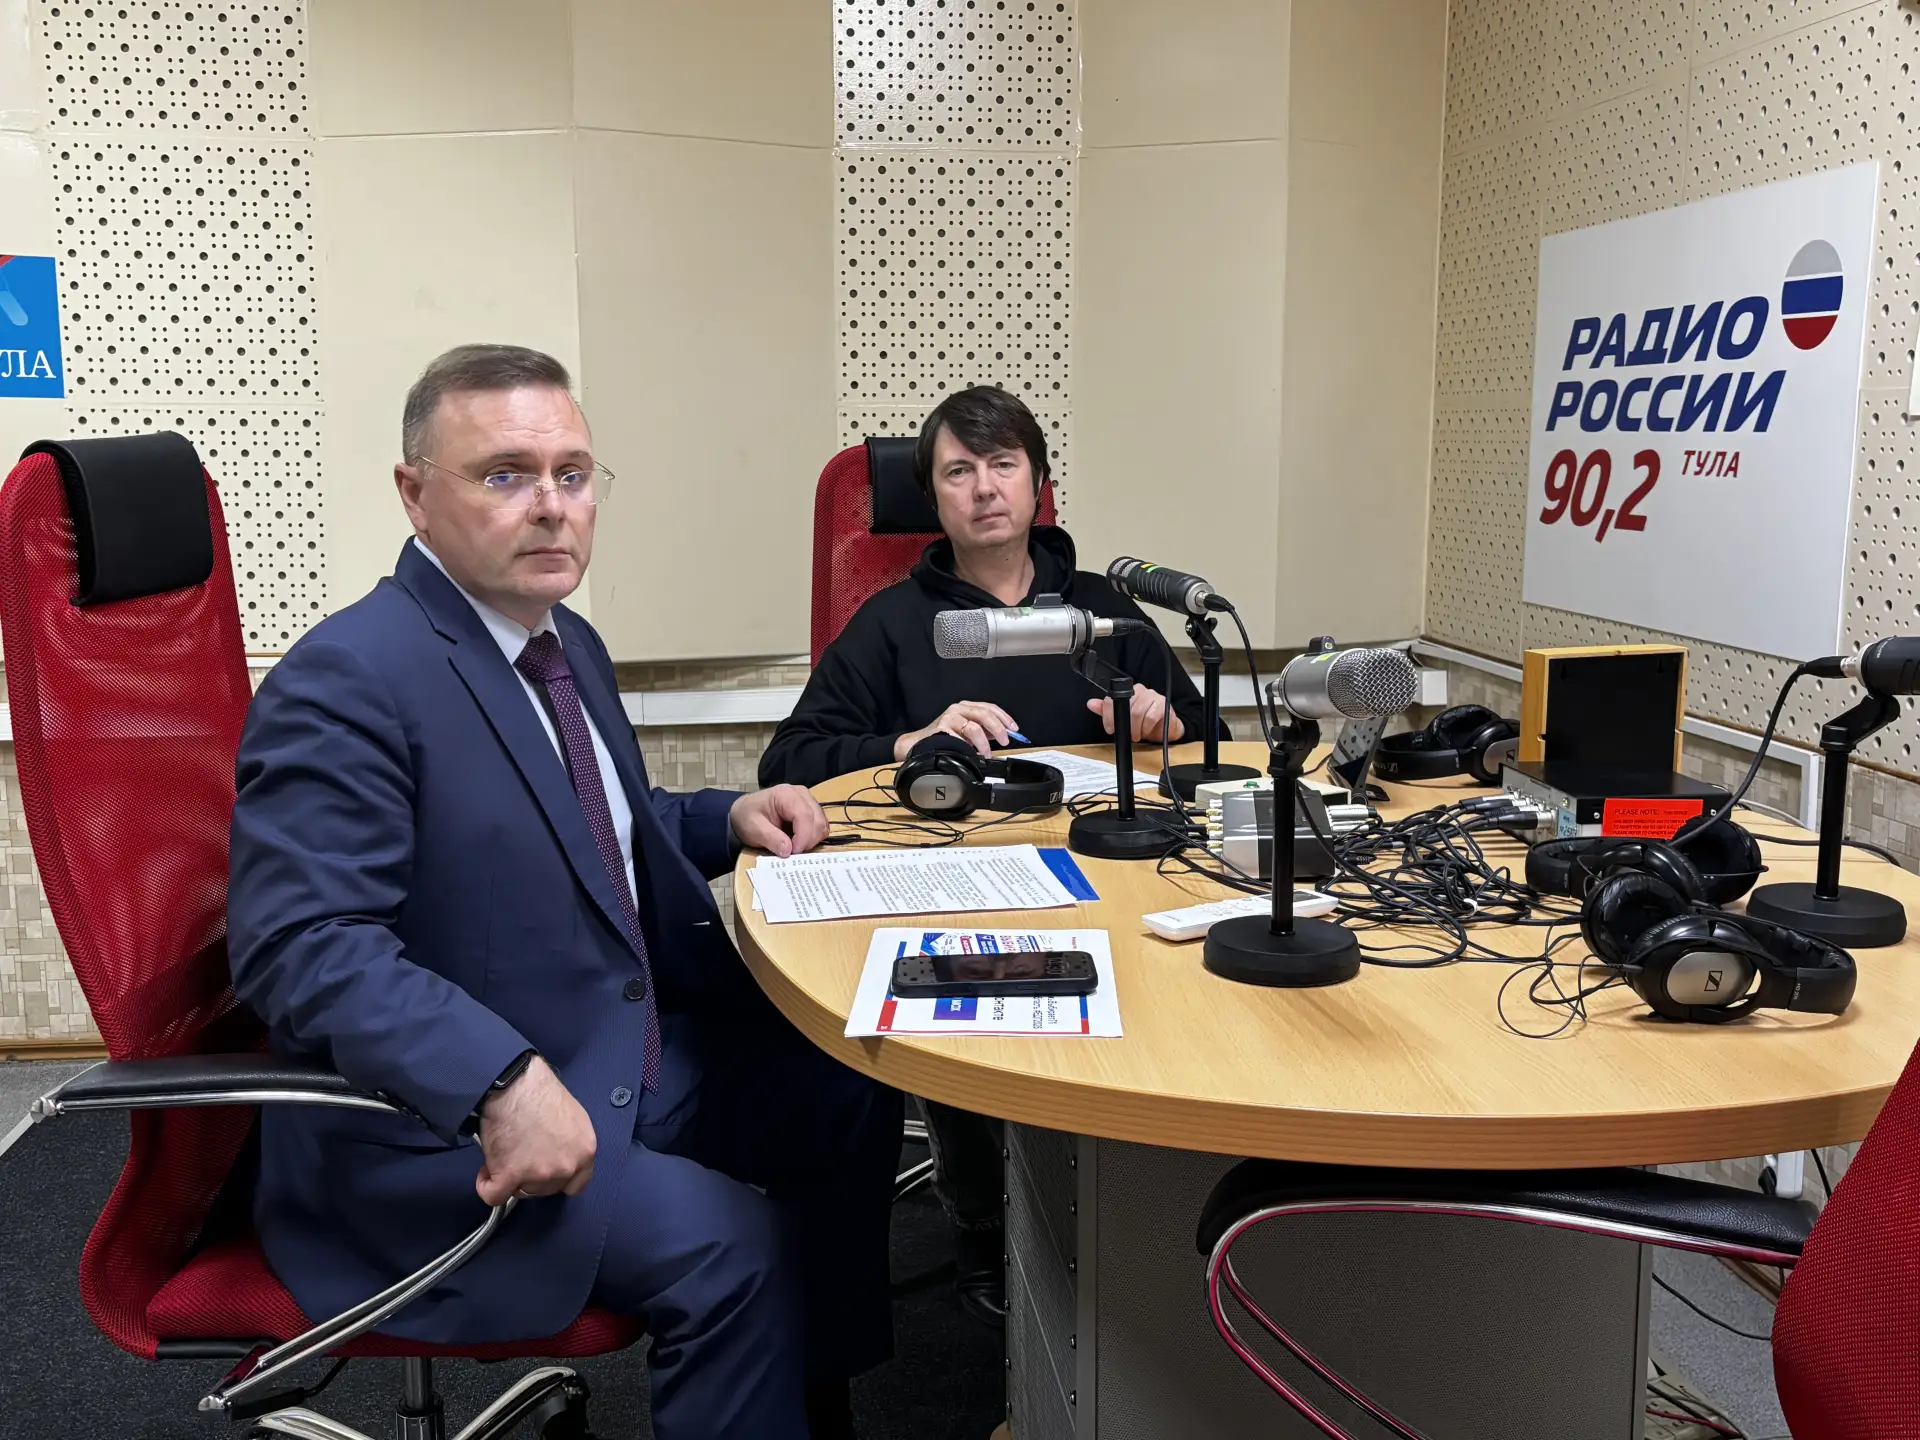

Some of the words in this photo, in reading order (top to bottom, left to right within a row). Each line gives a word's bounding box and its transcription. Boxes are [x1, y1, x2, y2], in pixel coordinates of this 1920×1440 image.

[1562, 296, 1769, 371] РАДИО
[1545, 370, 1787, 432] РОССИИ
[1539, 449, 1661, 543] 90,2
[1682, 450, 1740, 478] ТУЛА
